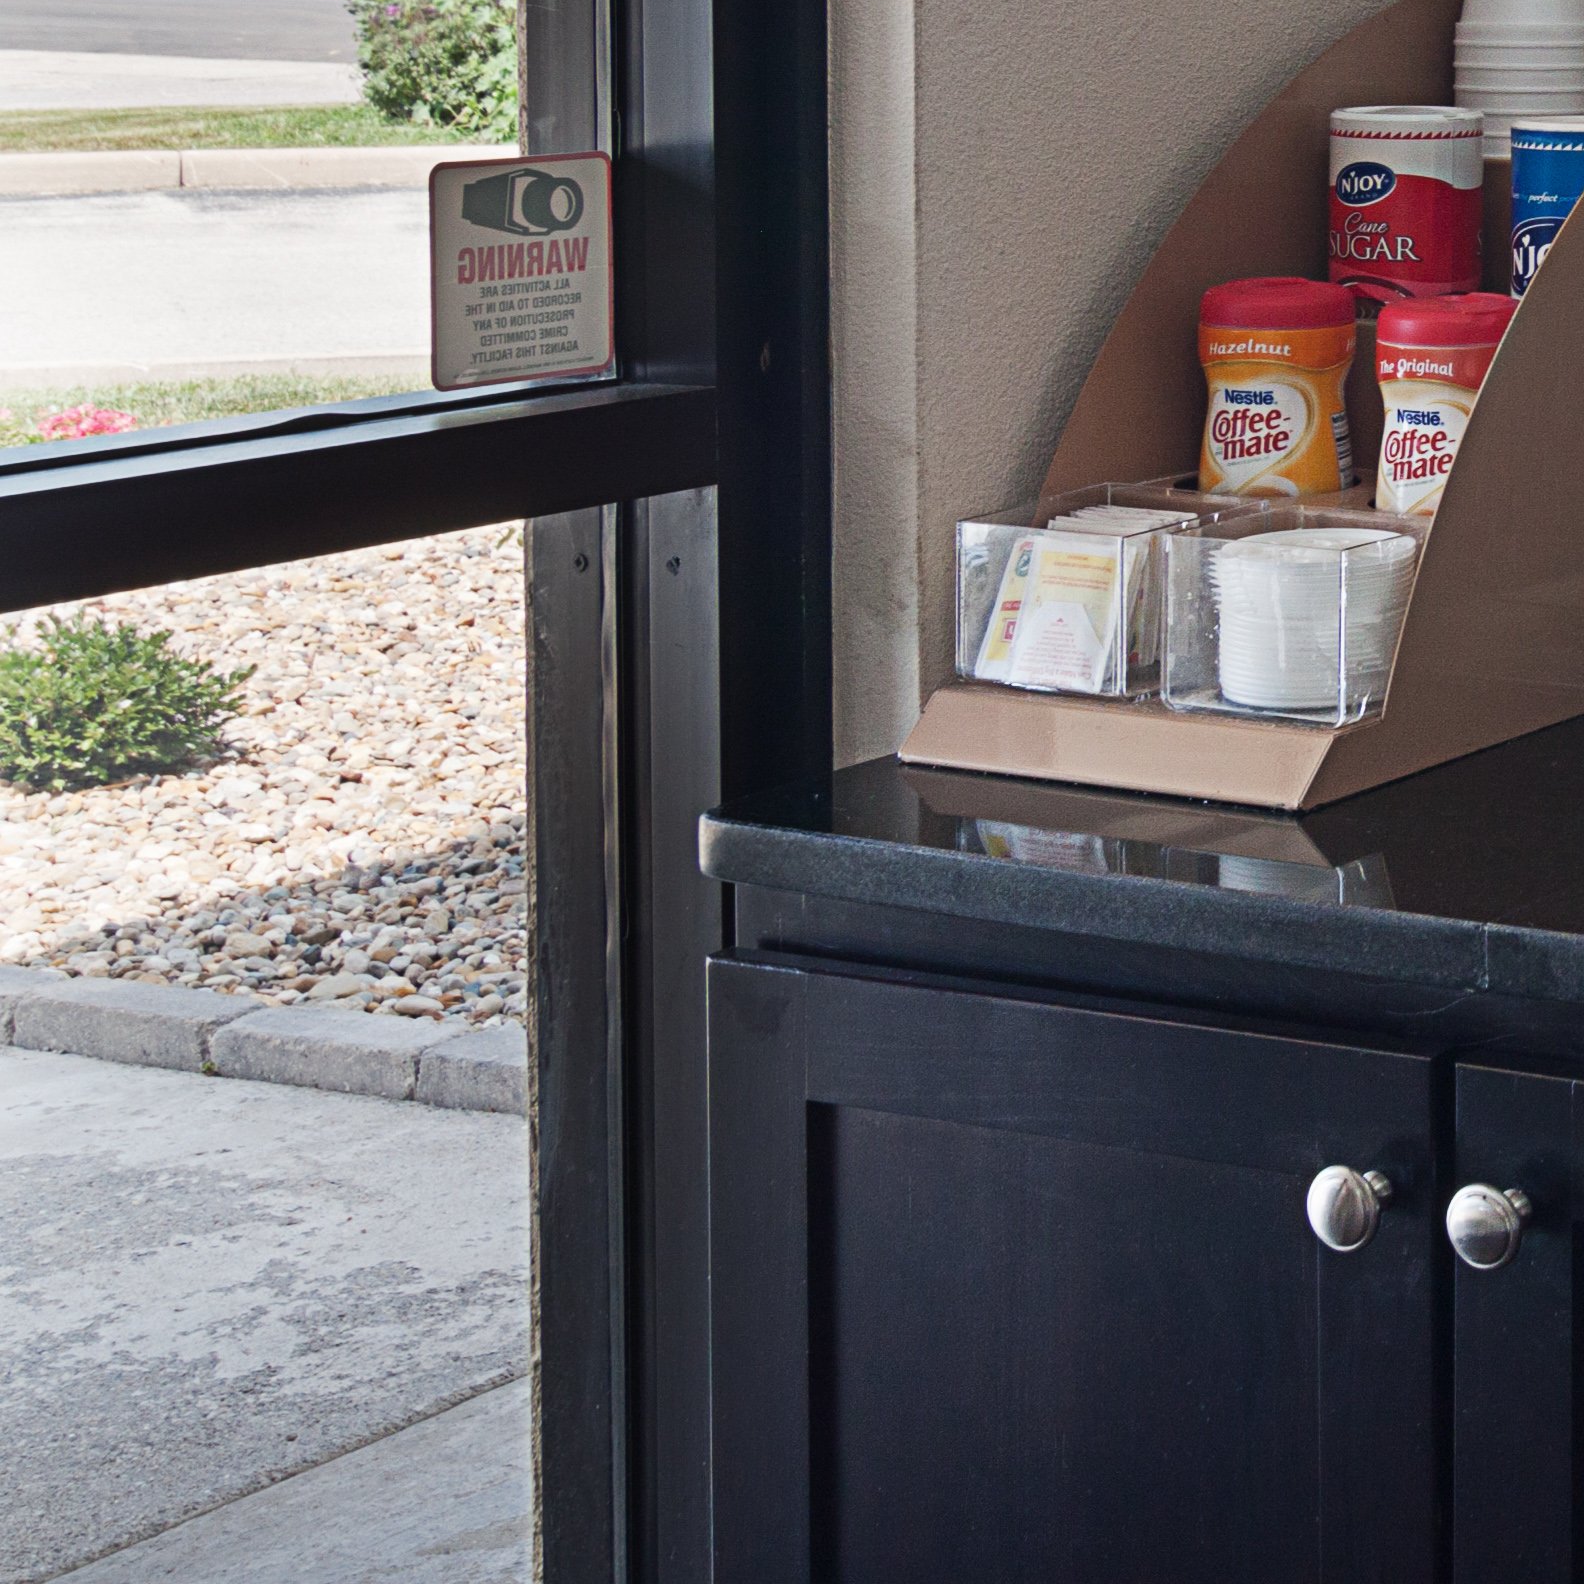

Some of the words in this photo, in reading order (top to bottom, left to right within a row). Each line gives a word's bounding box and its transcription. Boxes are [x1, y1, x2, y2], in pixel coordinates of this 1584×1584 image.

[1528, 191, 1558, 204] perfect
[1344, 212, 1388, 234] Cane
[1329, 229, 1422, 262] SUGAR
[1210, 339, 1292, 357] Hazelnut
[1380, 360, 1395, 374] The
[1397, 358, 1454, 377] Original
[1223, 430, 1290, 461] mate
[1392, 453, 1453, 481] mate
